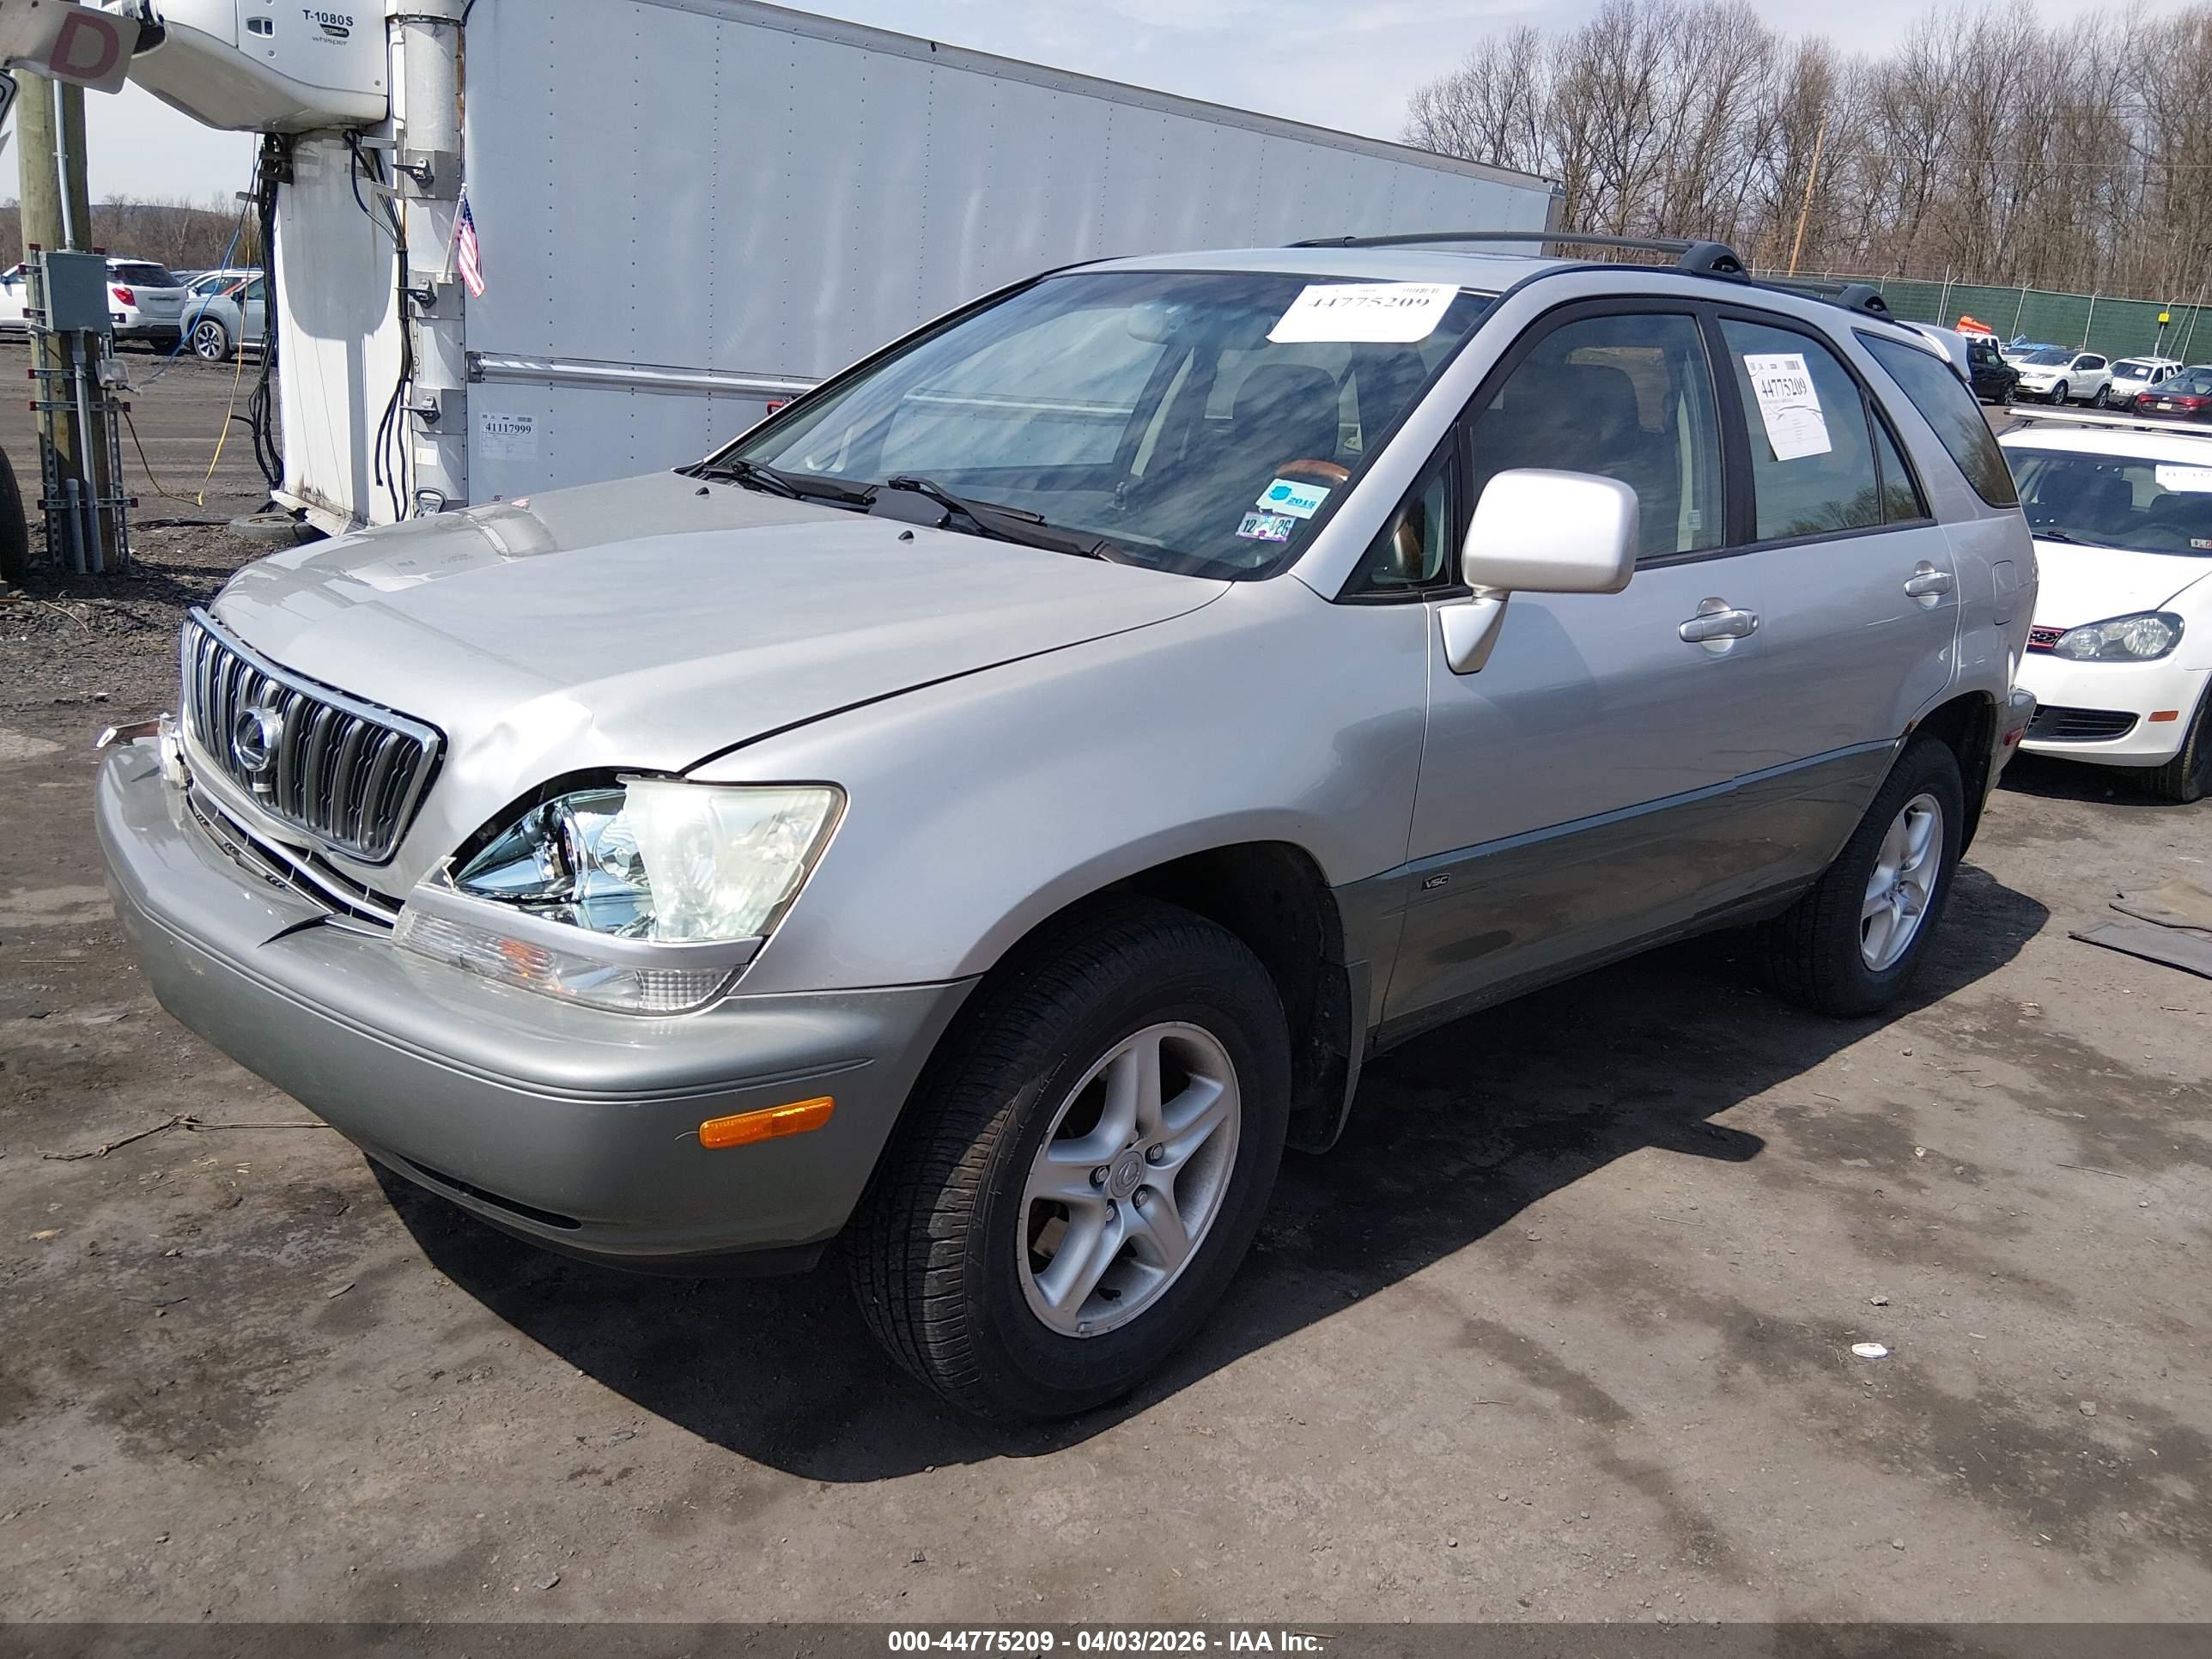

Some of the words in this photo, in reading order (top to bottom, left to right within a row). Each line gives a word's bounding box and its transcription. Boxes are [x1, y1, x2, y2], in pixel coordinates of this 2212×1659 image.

[302, 9, 354, 27] T-1080S
[50, 11, 119, 79] D
[1761, 377, 1808, 398] 44775209
[485, 422, 532, 434] 41117999
[1243, 519, 1257, 533] 12
[1273, 519, 1291, 536] 26
